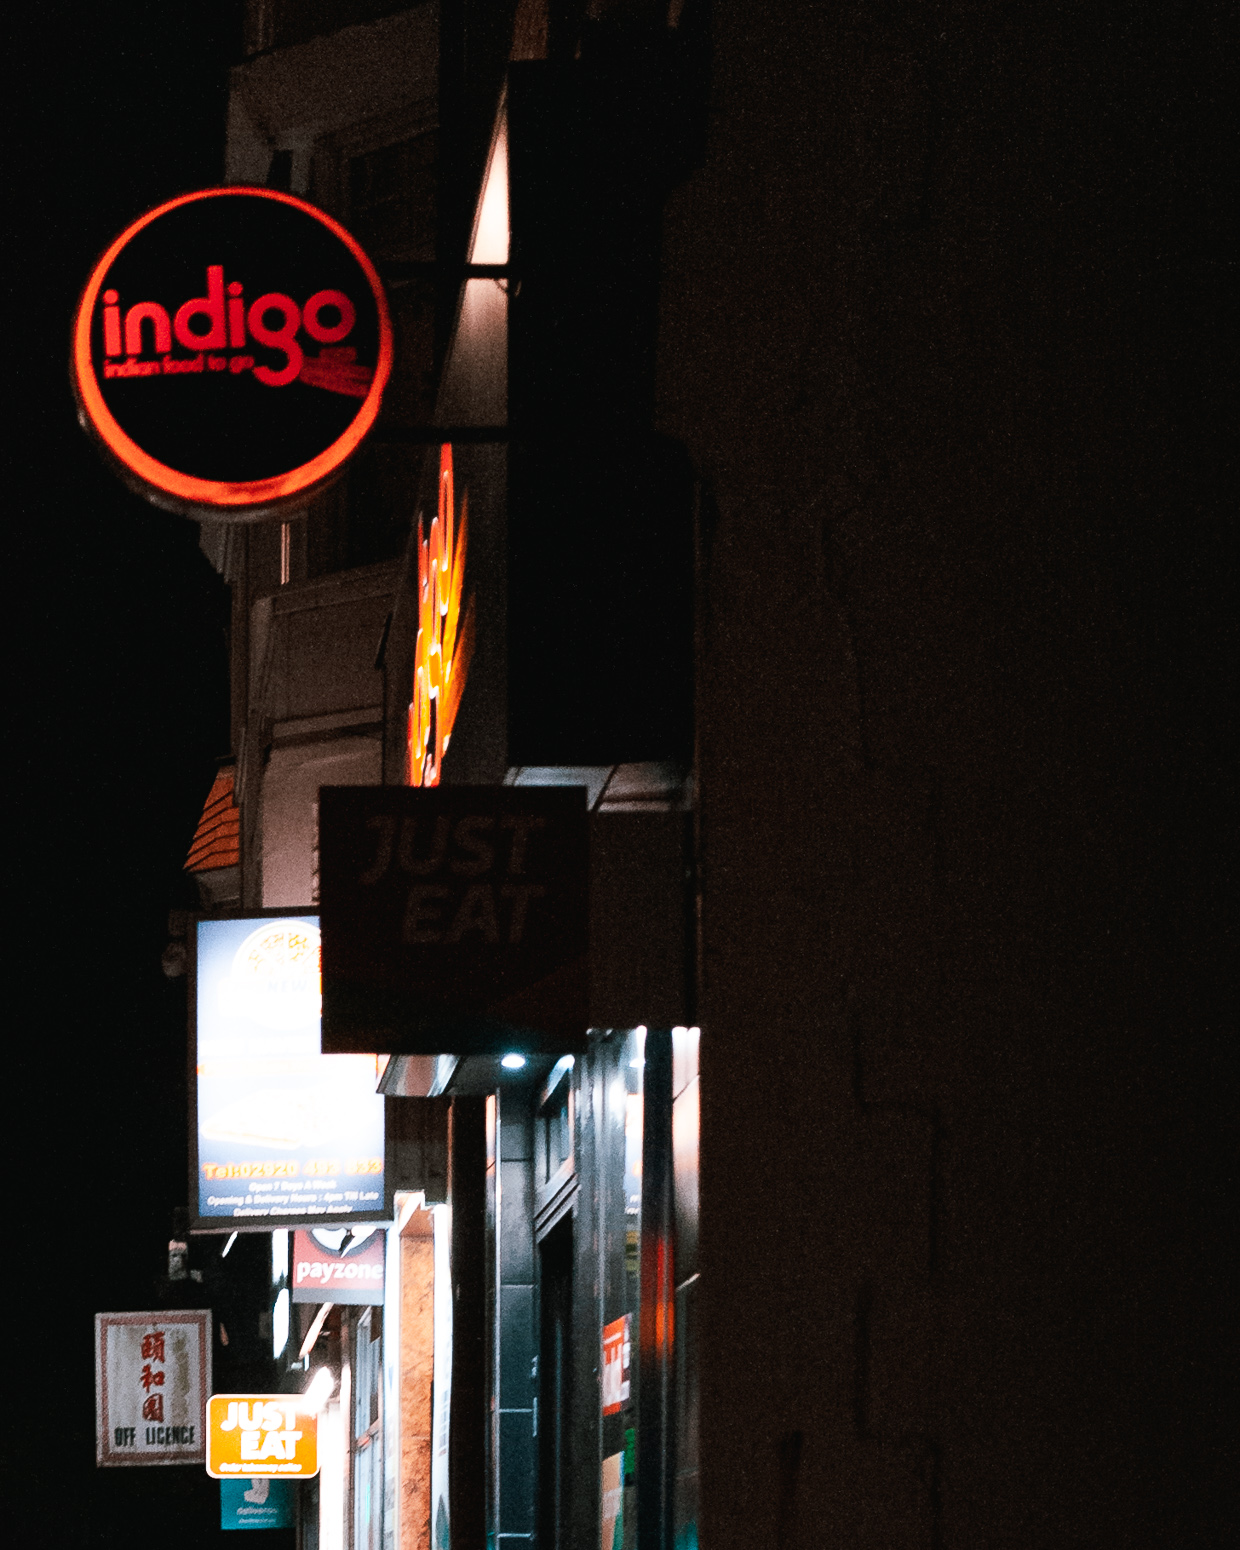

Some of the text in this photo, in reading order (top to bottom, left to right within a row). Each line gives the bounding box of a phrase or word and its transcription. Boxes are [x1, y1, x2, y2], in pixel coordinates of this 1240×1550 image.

[103, 264, 356, 386] indigo
[359, 814, 547, 885] JUST
[402, 883, 548, 944] EAT
[296, 1259, 383, 1285] payzone
[220, 1401, 298, 1432] JUST
[114, 1425, 196, 1447] OFF LICENCE
[240, 1430, 303, 1461] EAT
